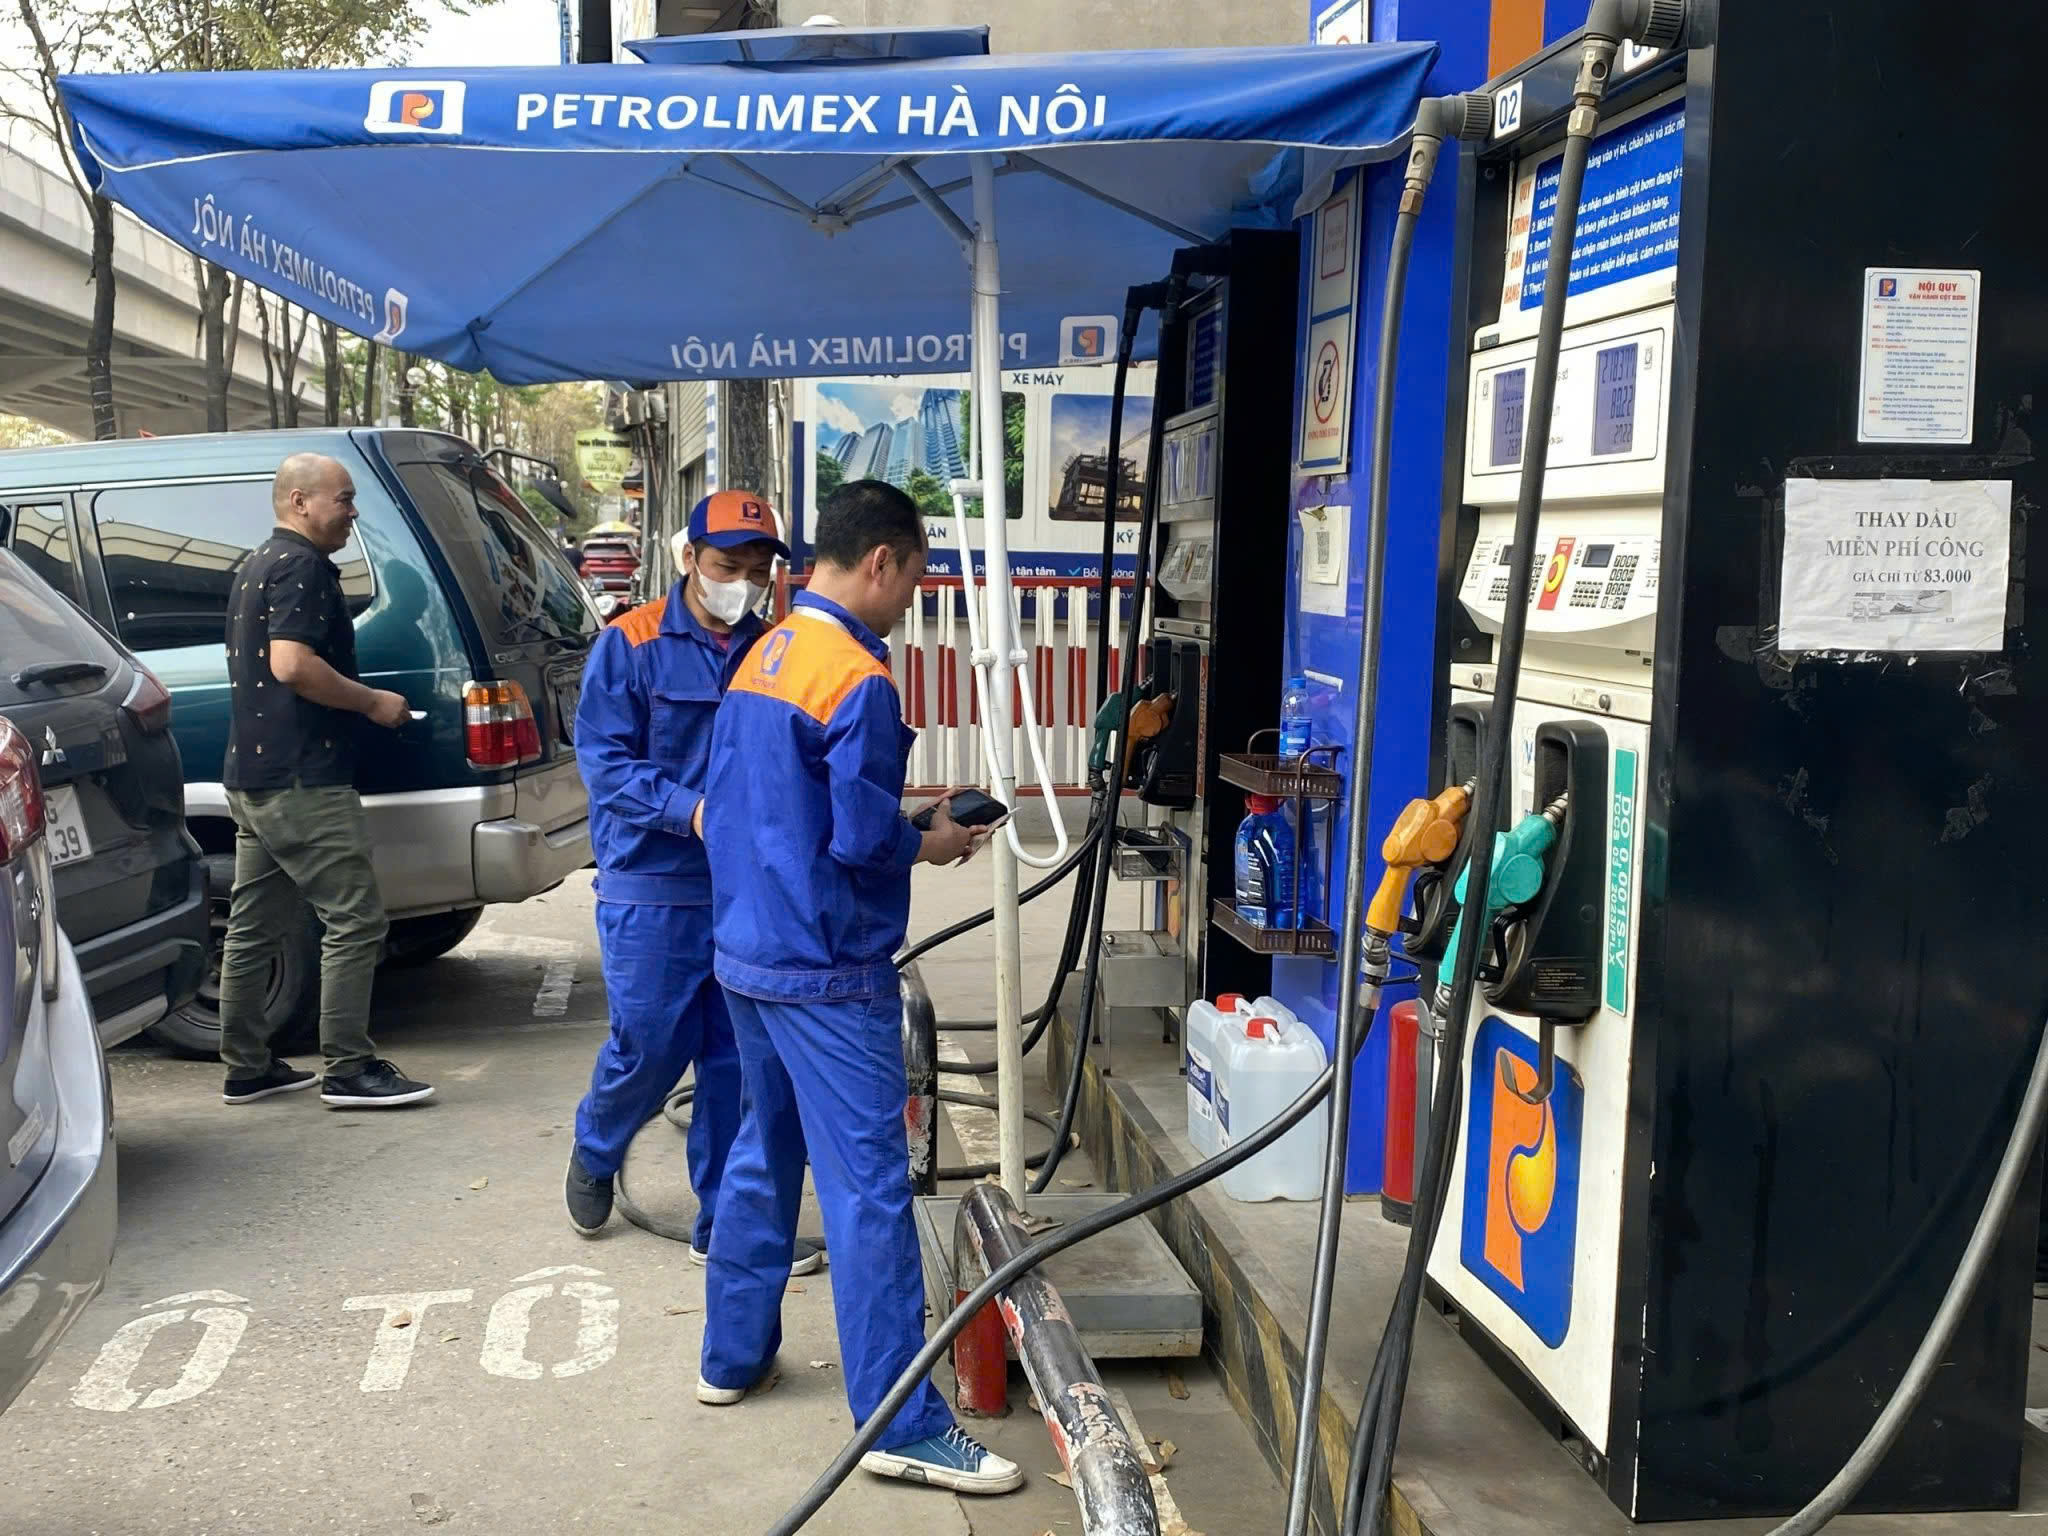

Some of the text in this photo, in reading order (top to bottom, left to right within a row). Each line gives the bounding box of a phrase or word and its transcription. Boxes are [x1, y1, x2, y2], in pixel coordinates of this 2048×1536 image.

[517, 93, 880, 133] PETROLIMEX
[898, 85, 979, 136] HÀ
[1499, 89, 1518, 129] 02
[1918, 281, 1958, 292] NỘI QUY
[1013, 371, 1064, 386] XE MÁY
[927, 522, 947, 538] ẢN
[1855, 511, 1910, 528] THAY
[1825, 535, 1984, 558] MIỄN PHÍ CÔNG
[1016, 566, 1034, 577] tận
[1035, 566, 1057, 577] tâm
[1924, 568, 1971, 583] 83.000
[1613, 793, 1621, 841] TCCS
[49, 826, 82, 863] .39
[1615, 795, 1632, 969] DO 0,001S-V
[71, 1289, 252, 1413] Ô
